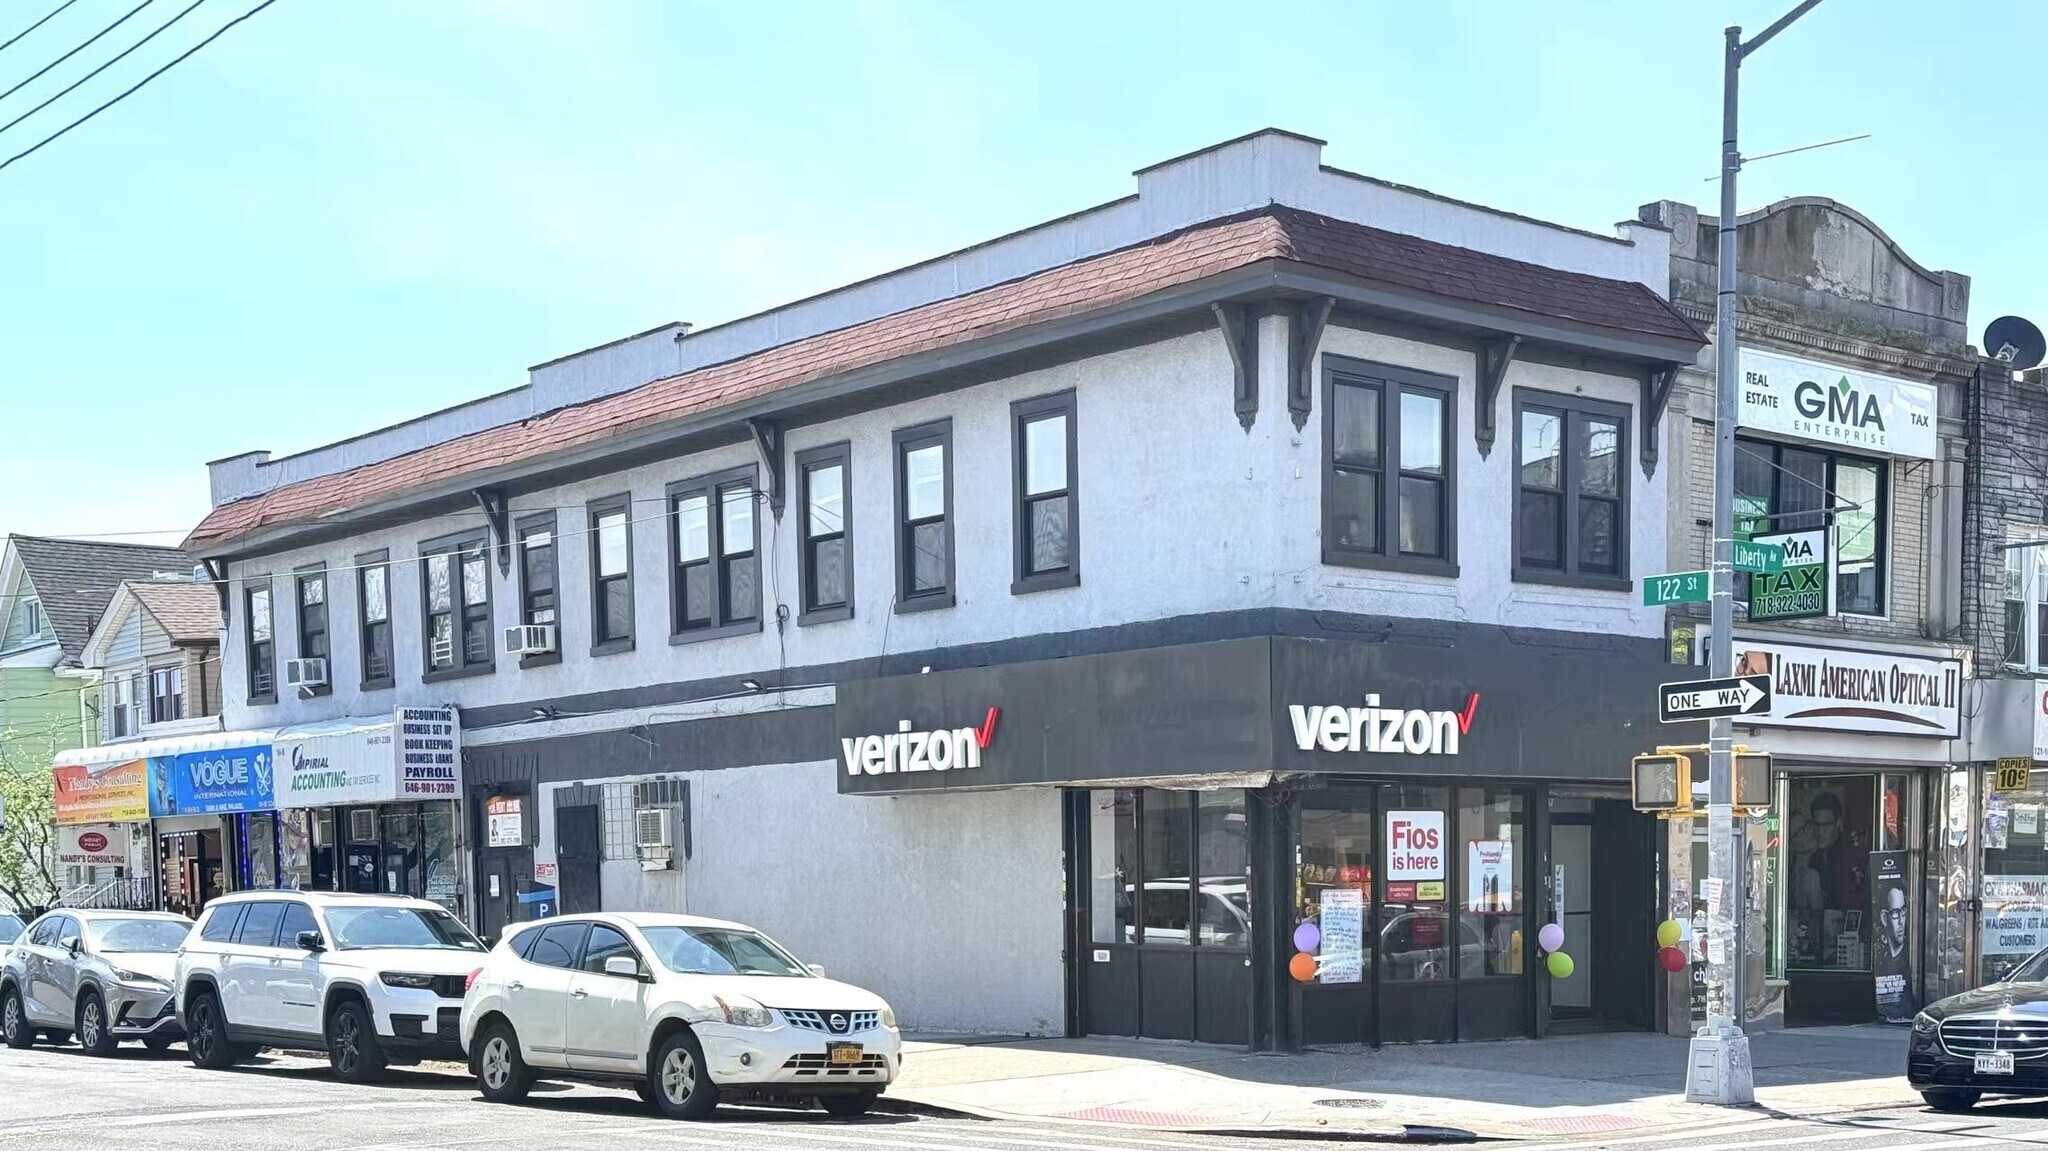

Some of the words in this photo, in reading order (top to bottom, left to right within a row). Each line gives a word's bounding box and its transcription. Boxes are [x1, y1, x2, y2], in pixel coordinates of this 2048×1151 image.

[1746, 372, 1769, 388] REAL
[1746, 391, 1778, 408] ESTATE
[1794, 380, 1886, 432] GMA
[1911, 413, 1929, 428] TAX
[1794, 420, 1886, 446] ENTERPRISE
[1782, 540, 1813, 559] MA
[1735, 545, 1767, 572] Liberty
[1656, 578, 1681, 602] 122
[1687, 576, 1698, 592] St
[1755, 567, 1821, 595] TAX
[1755, 593, 1820, 616] 718-322-4030
[1775, 654, 1817, 697] LAXMI
[1819, 657, 1887, 703] AMERICAN
[1890, 664, 1941, 707] OPTICAL
[1670, 693, 1701, 710] ONE
[1717, 688, 1750, 706] WAY
[403, 709, 452, 721] ACCOUNTING
[403, 723, 430, 735] BUSINESS
[432, 724, 442, 735] SET
[444, 725, 452, 736] UP
[1288, 693, 1459, 755] verizon
[405, 739, 424, 750] BOOK
[425, 739, 453, 750] KEEPING
[841, 719, 981, 776] verizon
[405, 753, 433, 764] BUSINESS
[435, 753, 453, 764] LOANS
[2000, 760, 2028, 769] COPIES
[101, 771, 142, 788] Consulting
[189, 757, 249, 788] VOGUE
[291, 771, 347, 791] ACCOUNTING
[405, 767, 454, 778] PAYROLL
[193, 789, 249, 799] INTERNATIONAL
[405, 782, 455, 794] 646-901-2399
[1392, 821, 1439, 850] Fios
[60, 854, 87, 863] NANDY'S
[87, 854, 125, 864] CONSULTING
[1392, 852, 1404, 870] is
[1407, 852, 1439, 870] here
[540, 903, 549, 917] P
[1985, 918, 2022, 930] WALGREENS
[2000, 934, 2036, 947] CUSTOMERS
